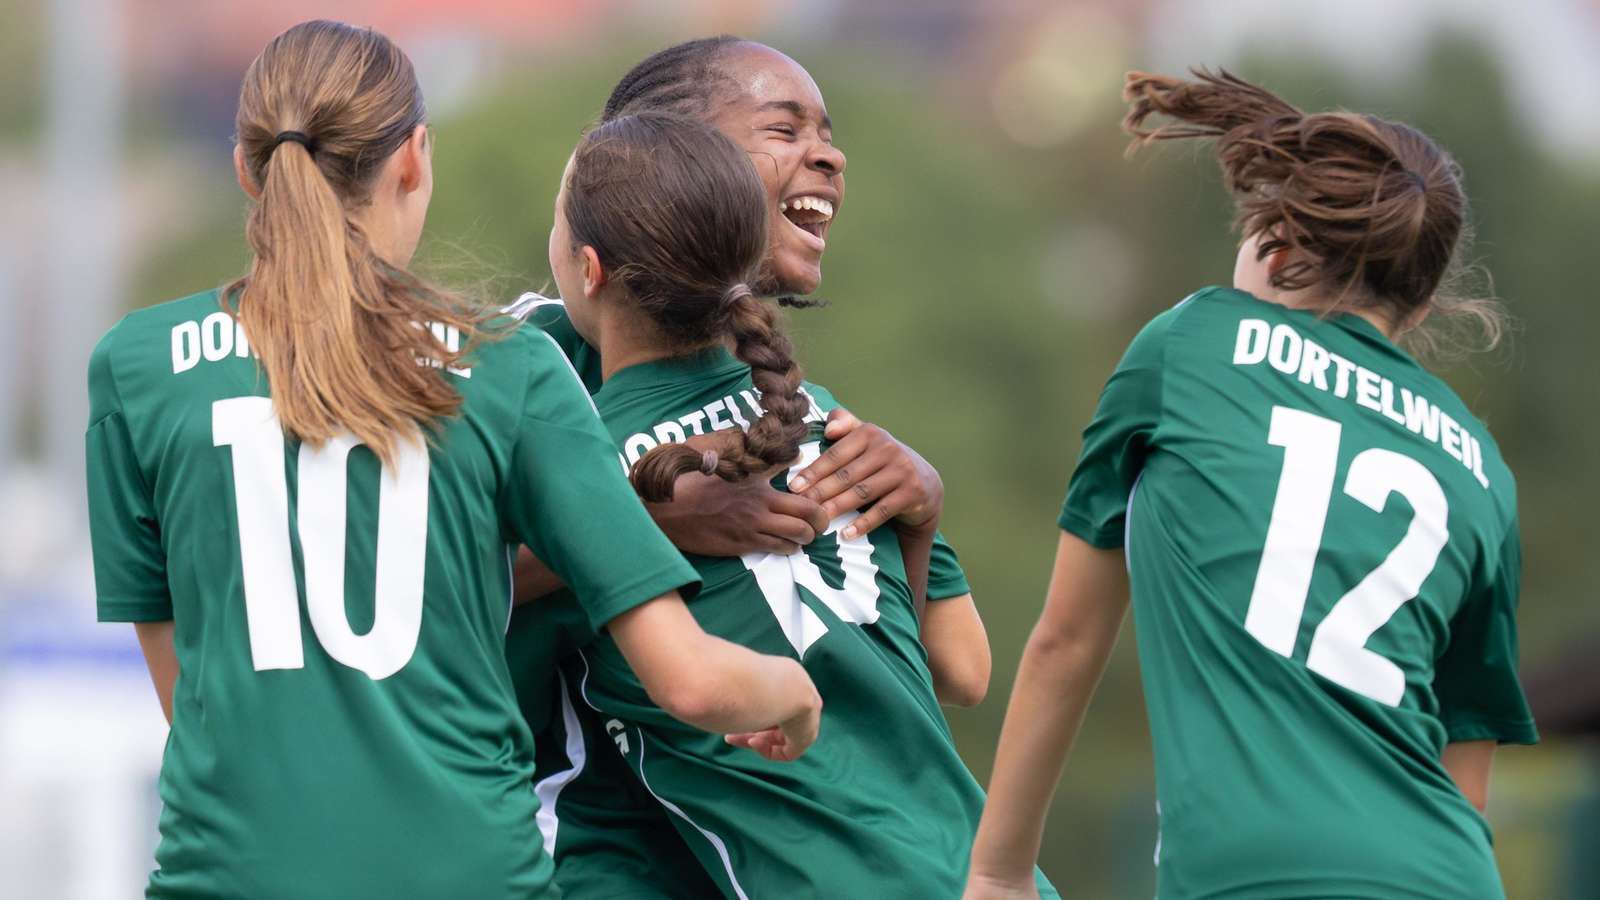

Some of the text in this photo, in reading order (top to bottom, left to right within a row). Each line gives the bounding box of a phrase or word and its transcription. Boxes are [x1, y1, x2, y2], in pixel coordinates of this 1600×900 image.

[212, 396, 430, 680] 10
[1233, 319, 1489, 489] DORTELWEIL
[1244, 405, 1449, 708] 12
